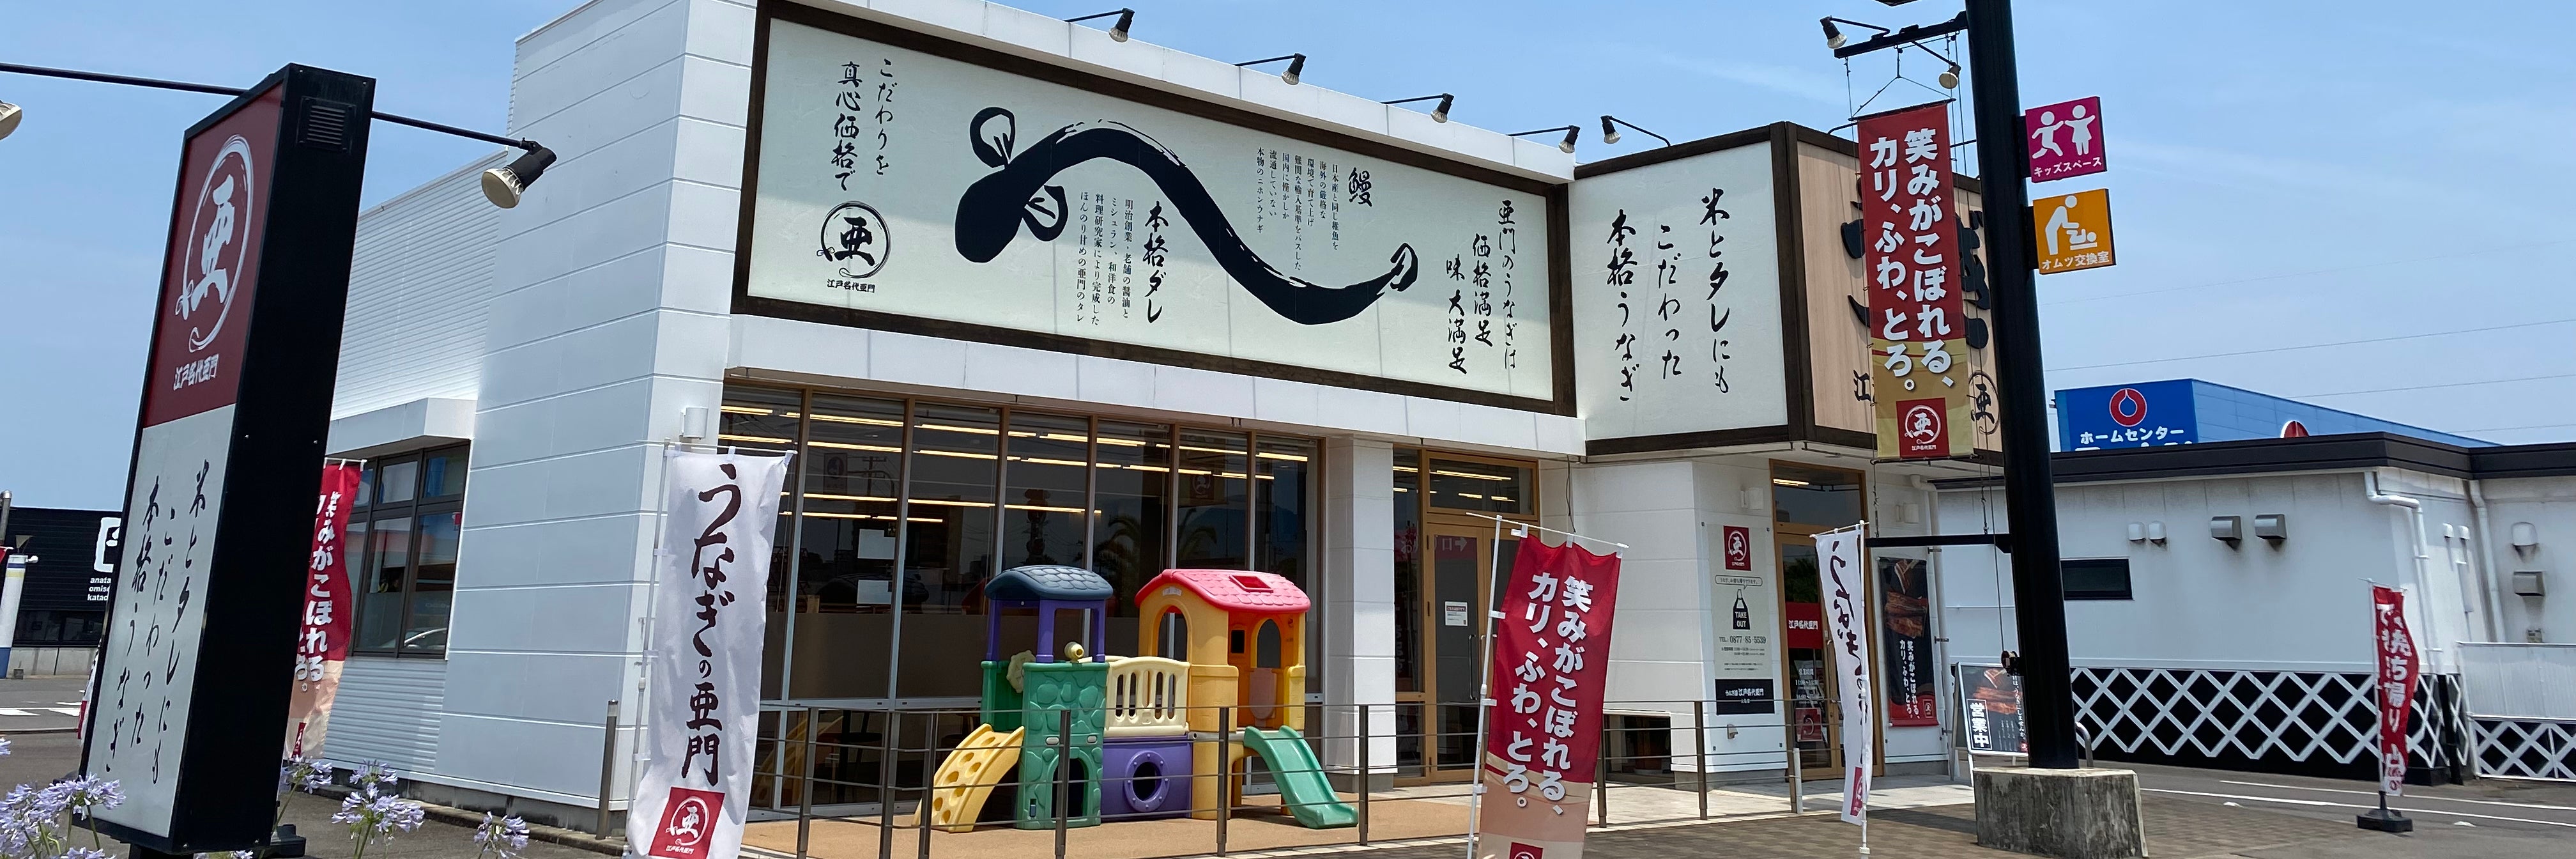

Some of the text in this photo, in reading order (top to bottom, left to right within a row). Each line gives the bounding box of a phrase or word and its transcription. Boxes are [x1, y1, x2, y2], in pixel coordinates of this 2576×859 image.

[831, 61, 862, 191] 真心価格で
[875, 58, 898, 176] こだわりを
[2034, 155, 2103, 178] キッズスペース
[827, 279, 876, 293] 江戸名代亜門
[1077, 191, 1089, 322] ほんのり甘めの亜門のタレ
[1091, 193, 1104, 326] 料理研究家により完成した
[1107, 197, 1118, 304] ミシュラン、和洋食の
[1122, 199, 1133, 318] 明治創業・老舗の醤油と
[1142, 200, 1169, 323] 本格ダレ
[1472, 233, 1493, 347] 価格満足
[1498, 200, 1517, 369] 亜門のうなぎは
[1607, 208, 1640, 402] 本格うなぎ
[1657, 224, 1682, 380] こだわった
[1699, 187, 1730, 394] 米とタレにも
[1869, 136, 1915, 392] カリ、ふわ、とろ。
[1904, 127, 1954, 389] 笑みがこぼれる、
[2041, 250, 2110, 270] オムツ交換室
[2080, 426, 2184, 445] ホームセンター
[105, 474, 159, 772] 本格うなぎ
[130, 506, 175, 748] こだわった
[151, 458, 210, 785] 米とタレにも
[682, 463, 742, 787] うなぎの亜門
[1503, 571, 1558, 808] カリ、ふわ、とろ。
[1537, 575, 1593, 816] 笑みがこぼれる、
[1970, 702, 1989, 748] 営業中
